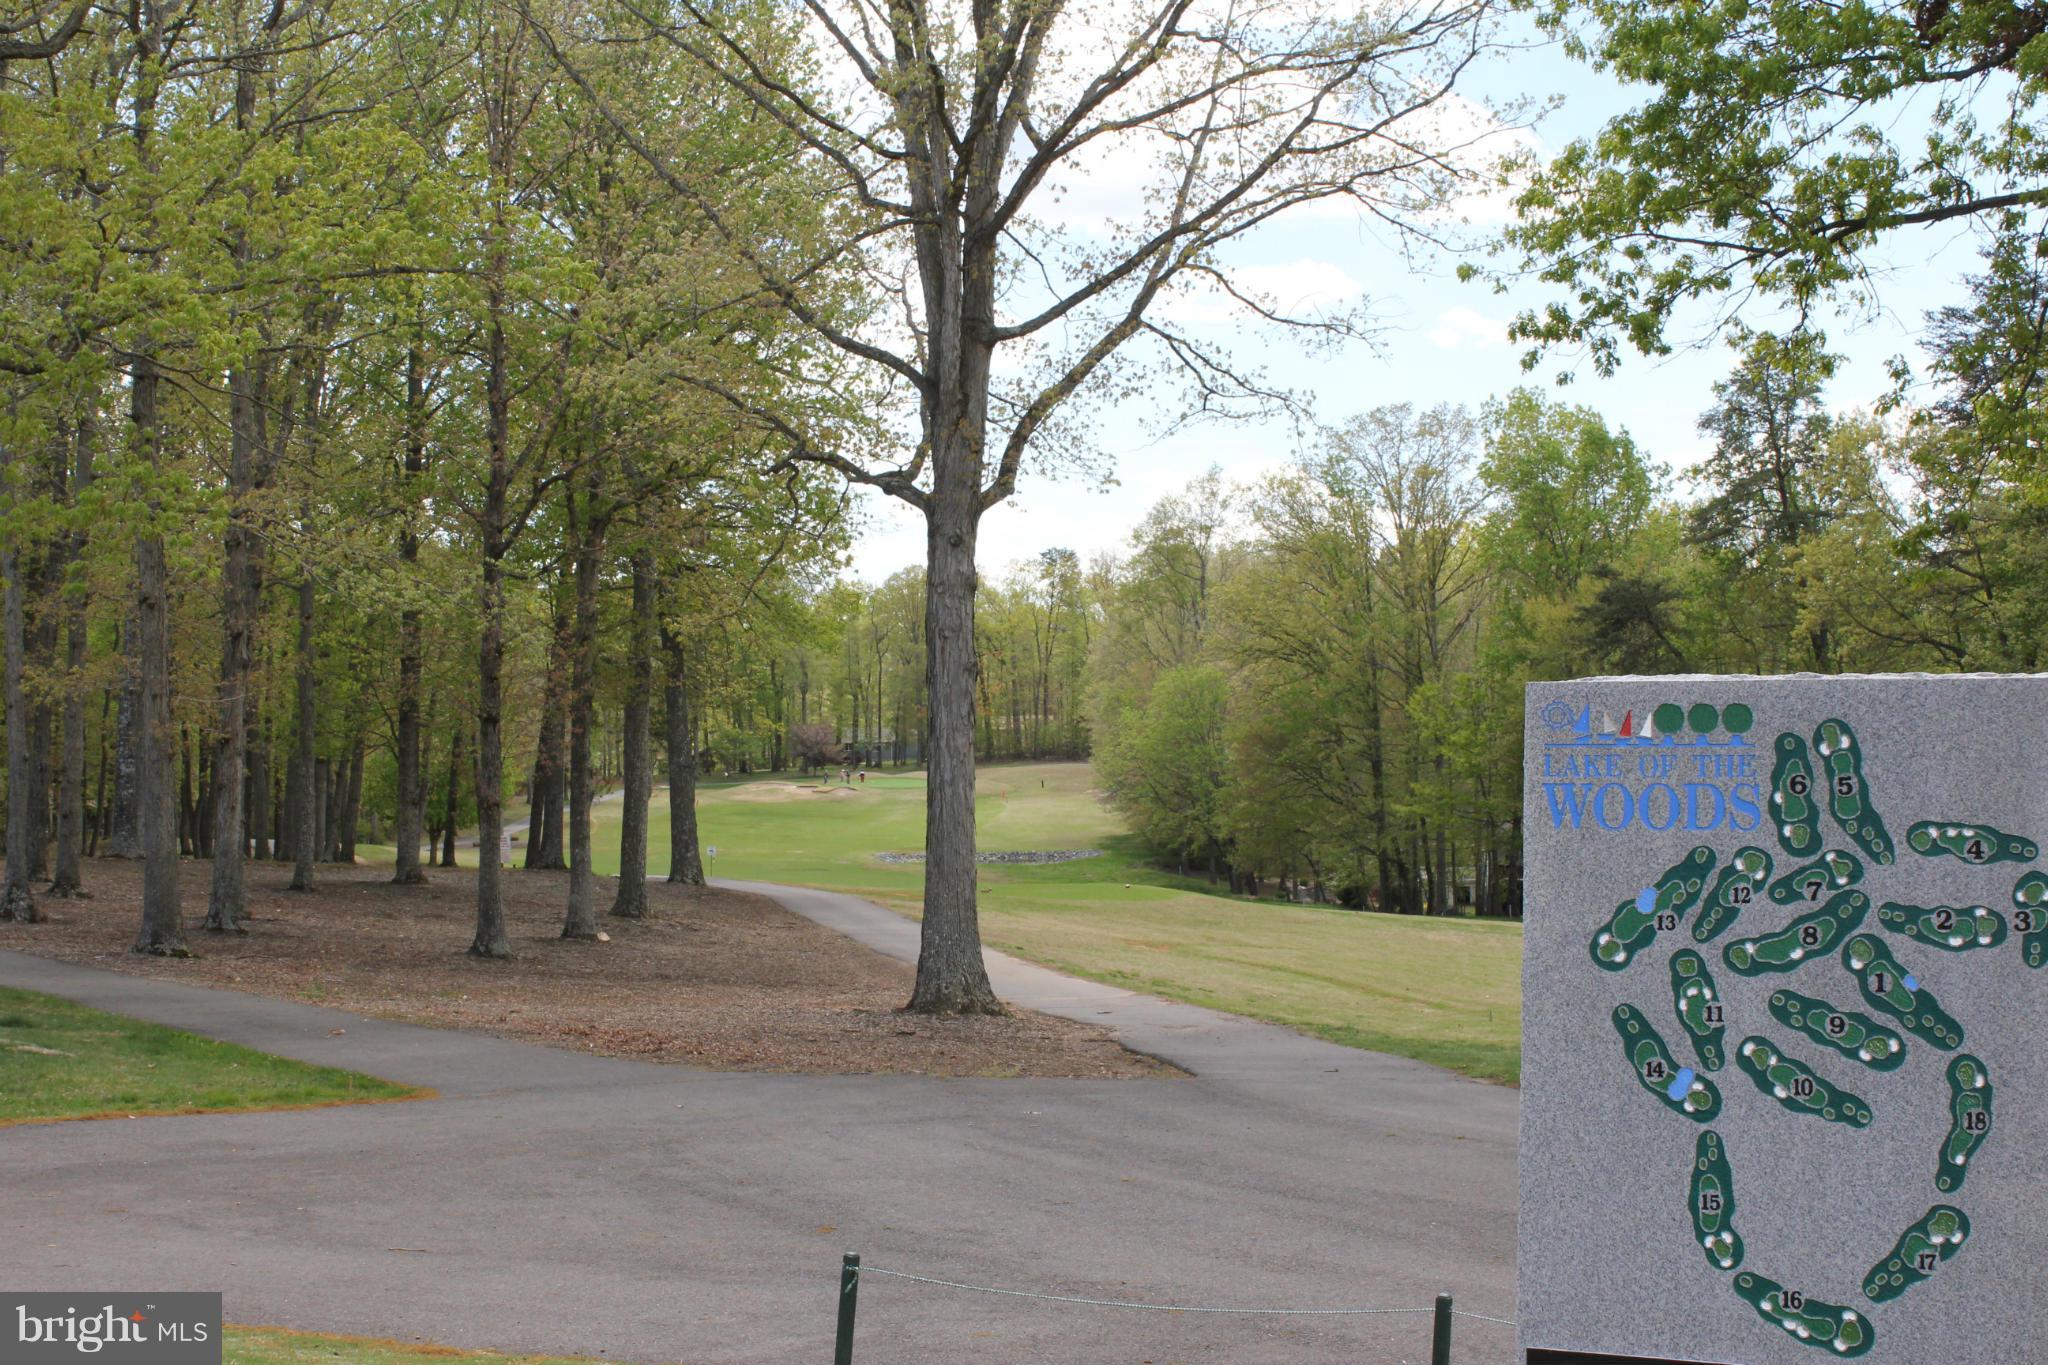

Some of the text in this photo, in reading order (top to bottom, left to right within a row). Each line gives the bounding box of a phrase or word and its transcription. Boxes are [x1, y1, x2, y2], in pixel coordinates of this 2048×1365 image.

[1543, 754, 1756, 777] LAKE OF THE
[1789, 775, 1807, 794] 6
[1838, 776, 1853, 795] 5
[1543, 782, 1761, 832] WOODS
[1967, 840, 1984, 859] 4
[1732, 887, 1751, 904] 12
[1807, 882, 1822, 901] 7
[1656, 914, 1676, 932] 13
[1936, 910, 1953, 930] 2
[2014, 912, 2031, 931] 3
[1803, 927, 1819, 946] 8
[1874, 973, 1887, 993] 1
[1705, 1005, 1724, 1023] 11
[1829, 1016, 1845, 1034] 9
[1645, 1061, 1664, 1079] 14
[1793, 1078, 1813, 1097] 10
[1966, 1112, 1986, 1130] 18
[1701, 1193, 1720, 1211] 15
[1918, 1253, 1937, 1270] 17
[1782, 1291, 1802, 1309] 16
